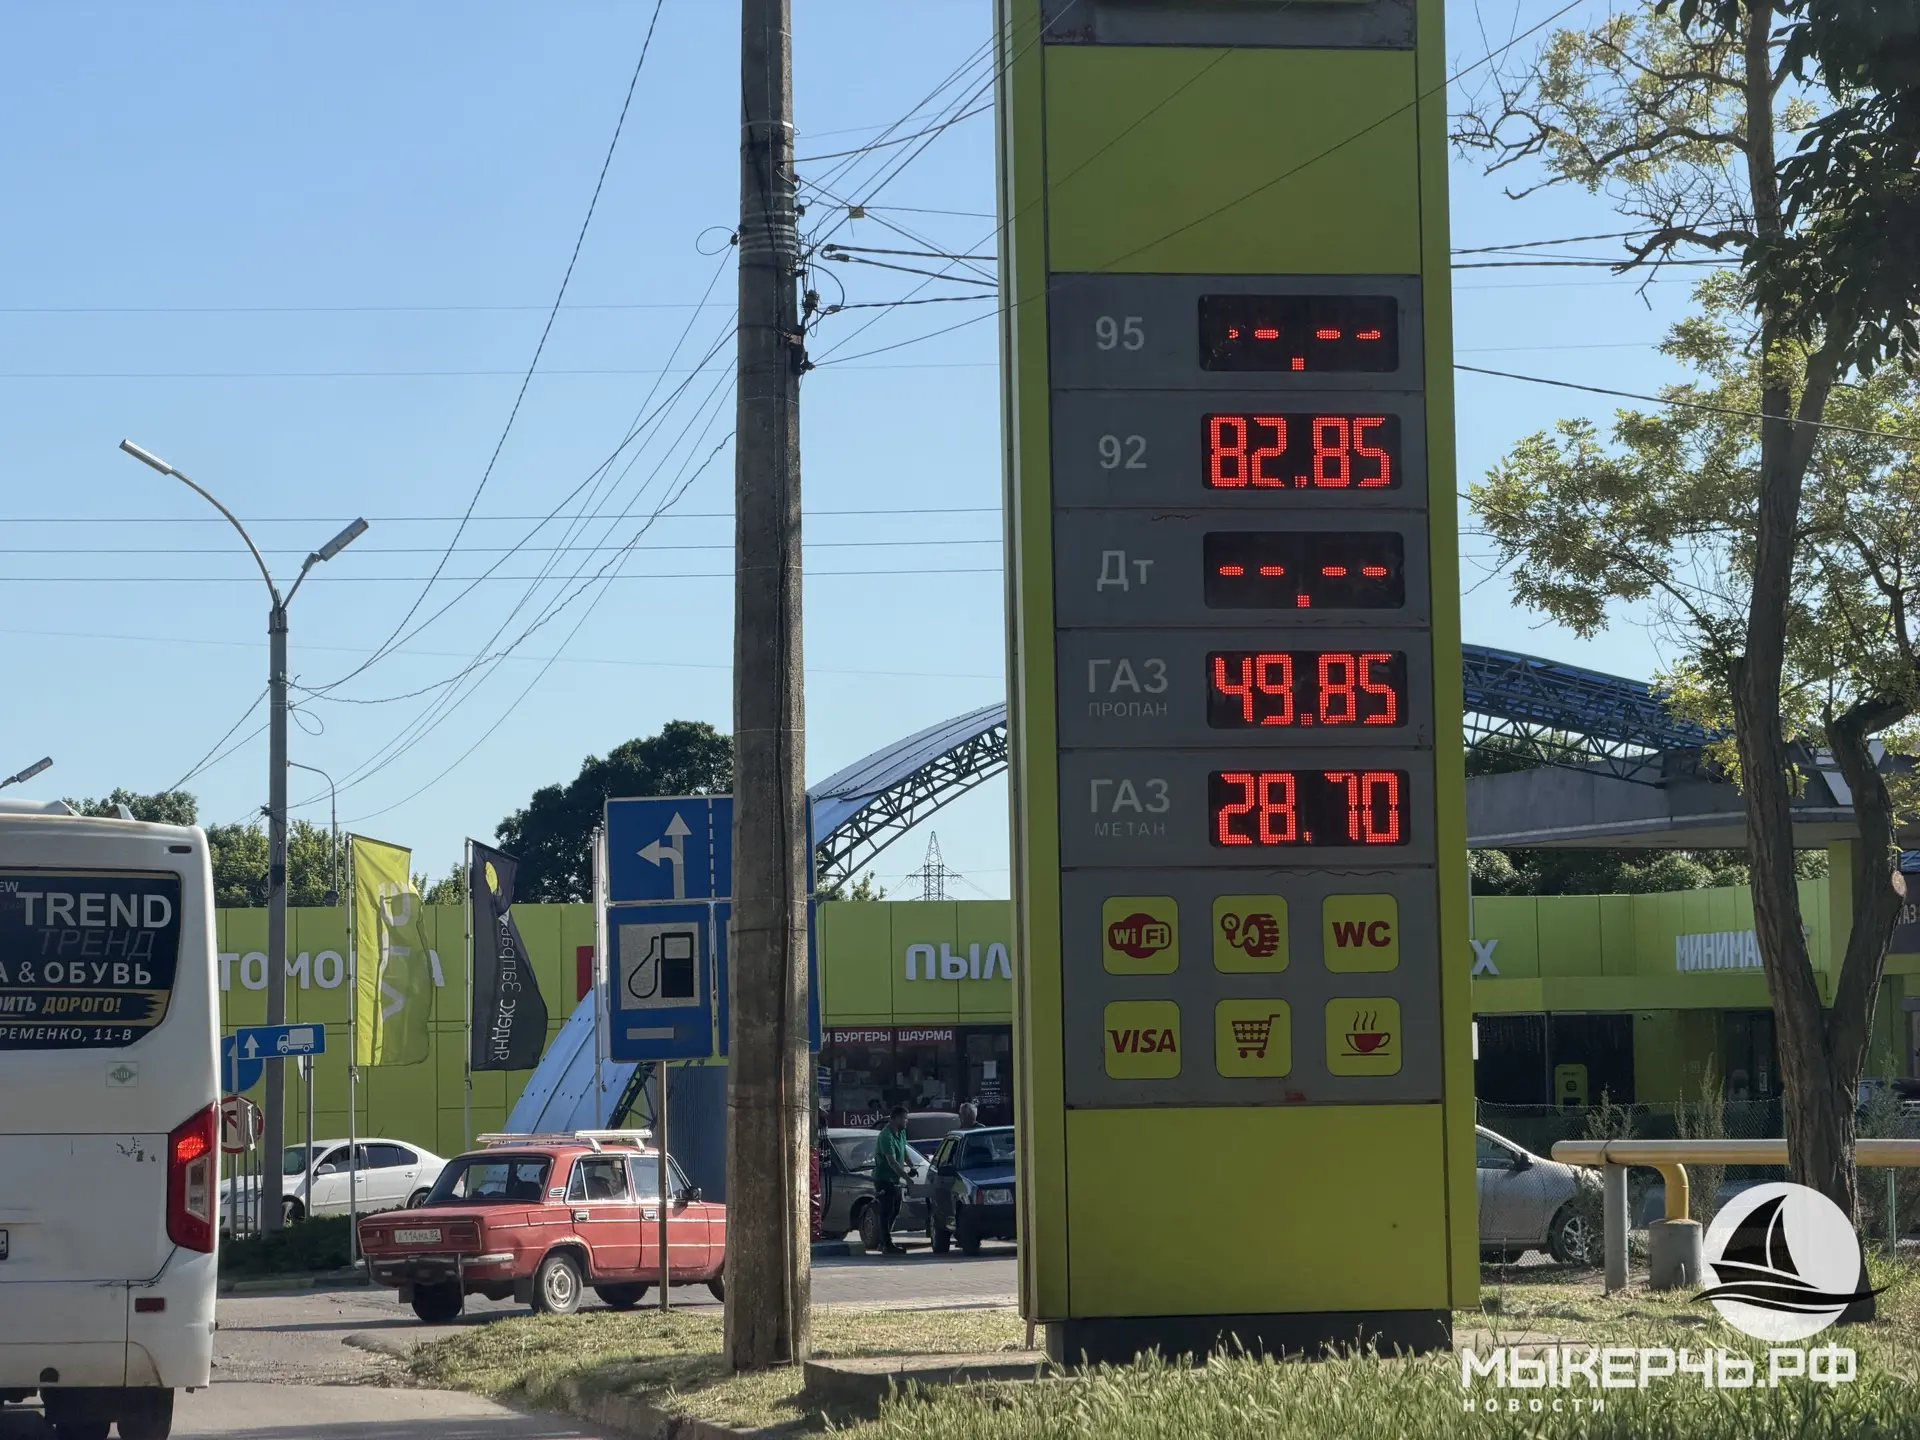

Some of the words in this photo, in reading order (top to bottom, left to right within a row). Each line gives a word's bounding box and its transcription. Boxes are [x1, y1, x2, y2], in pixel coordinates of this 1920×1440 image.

[1096, 316, 1145, 351] 95
[1099, 434, 1148, 469] 92
[1210, 416, 1390, 488] 82.85
[1096, 550, 1155, 592] Дт
[1088, 658, 1169, 694] ГАЗ
[1215, 653, 1397, 726] 49.85
[1088, 701, 1168, 717] ПРОПАН
[1090, 778, 1171, 814] ГАЗ
[1218, 772, 1400, 846] 28.70
[1094, 821, 1167, 837] МЕТАН
[16, 892, 172, 928] TREND
[38, 928, 157, 962] ТРЕНД
[1332, 920, 1392, 948] WC
[18, 961, 36, 983] &
[43, 961, 153, 985] ОБУВЬ
[905, 942, 1013, 981] ПЫЛ
[0, 996, 37, 1012] ИТЬ
[41, 996, 122, 1015] ДОРОГО!
[834, 1031, 891, 1043] БУРГЕРЫ
[898, 1030, 953, 1042] ШАУРМА
[1106, 1028, 1177, 1054] VISA
